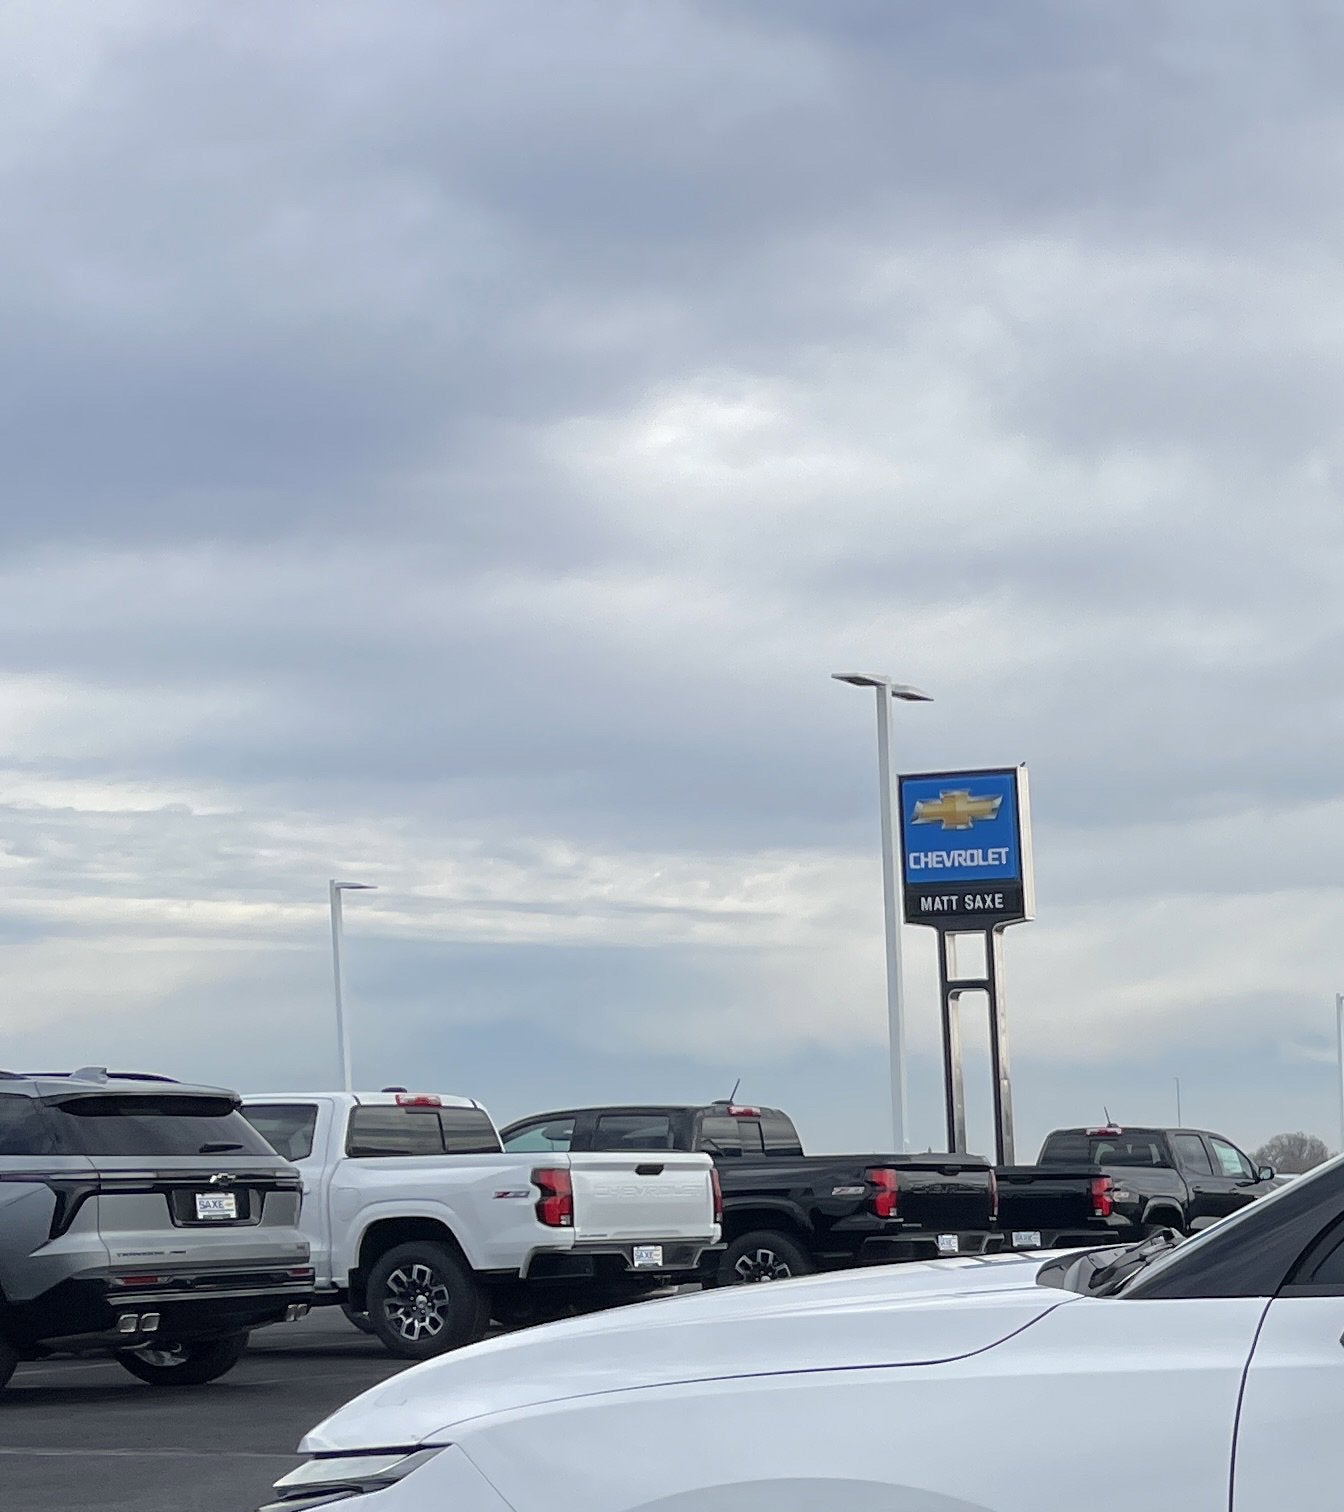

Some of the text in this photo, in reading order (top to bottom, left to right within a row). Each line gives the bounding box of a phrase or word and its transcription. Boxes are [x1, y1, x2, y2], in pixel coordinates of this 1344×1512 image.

[909, 847, 1009, 869] CHEVROLET
[920, 892, 1004, 912] MATT SAXE
[199, 1200, 224, 1209] SAXE
